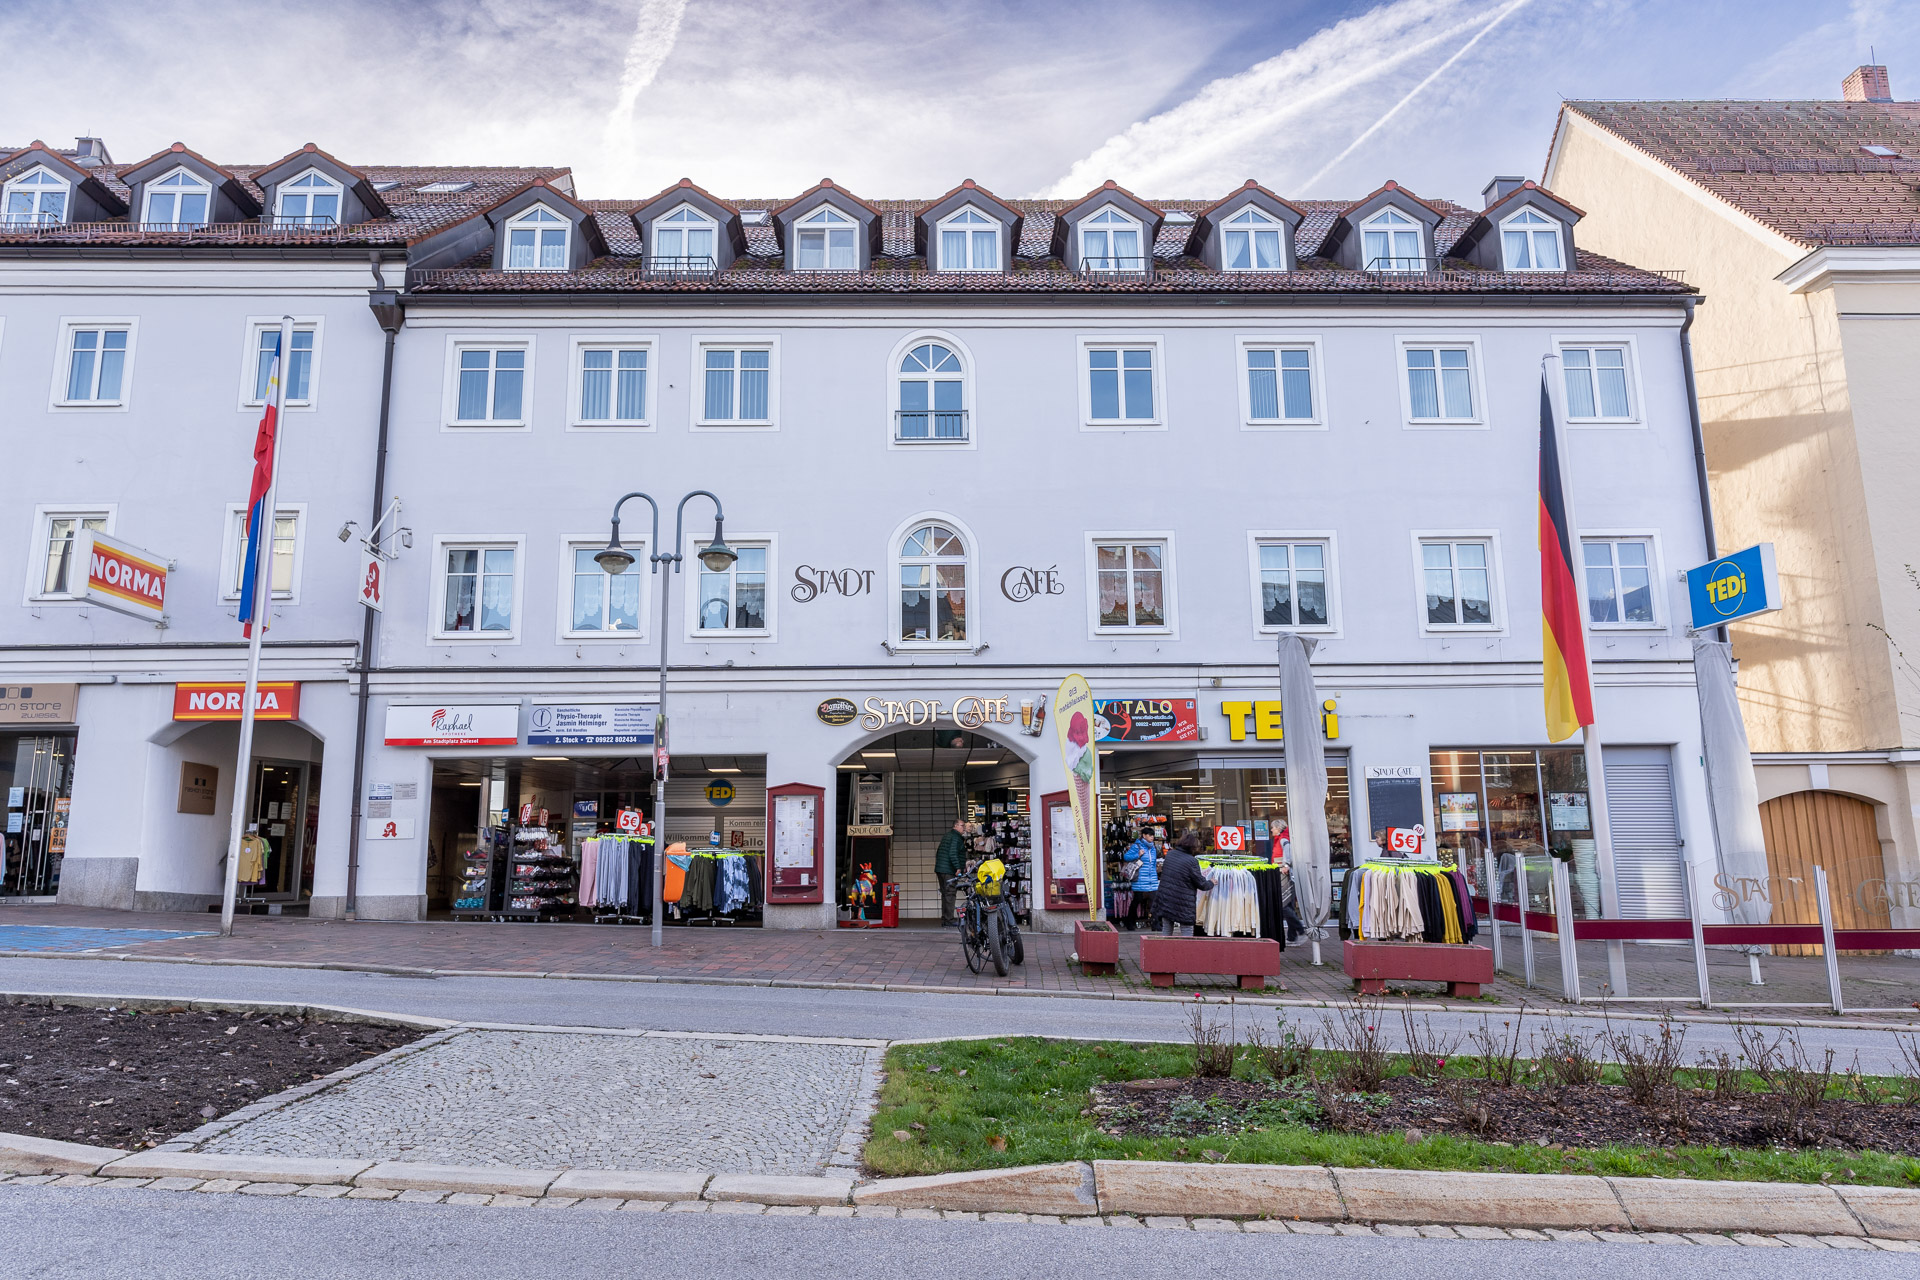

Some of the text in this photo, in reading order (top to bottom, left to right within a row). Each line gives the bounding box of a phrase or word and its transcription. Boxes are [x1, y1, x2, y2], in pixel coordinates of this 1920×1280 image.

[90, 552, 164, 601] NORMA
[1706, 572, 1747, 604] TEDi
[435, 713, 474, 732] Raphael
[1221, 699, 1340, 741] TEi
[704, 787, 736, 799] TEDi
[1132, 792, 1148, 806] 1€
[622, 814, 638, 828] 5€
[1220, 831, 1239, 847] 3€
[1394, 832, 1415, 849] 5€
